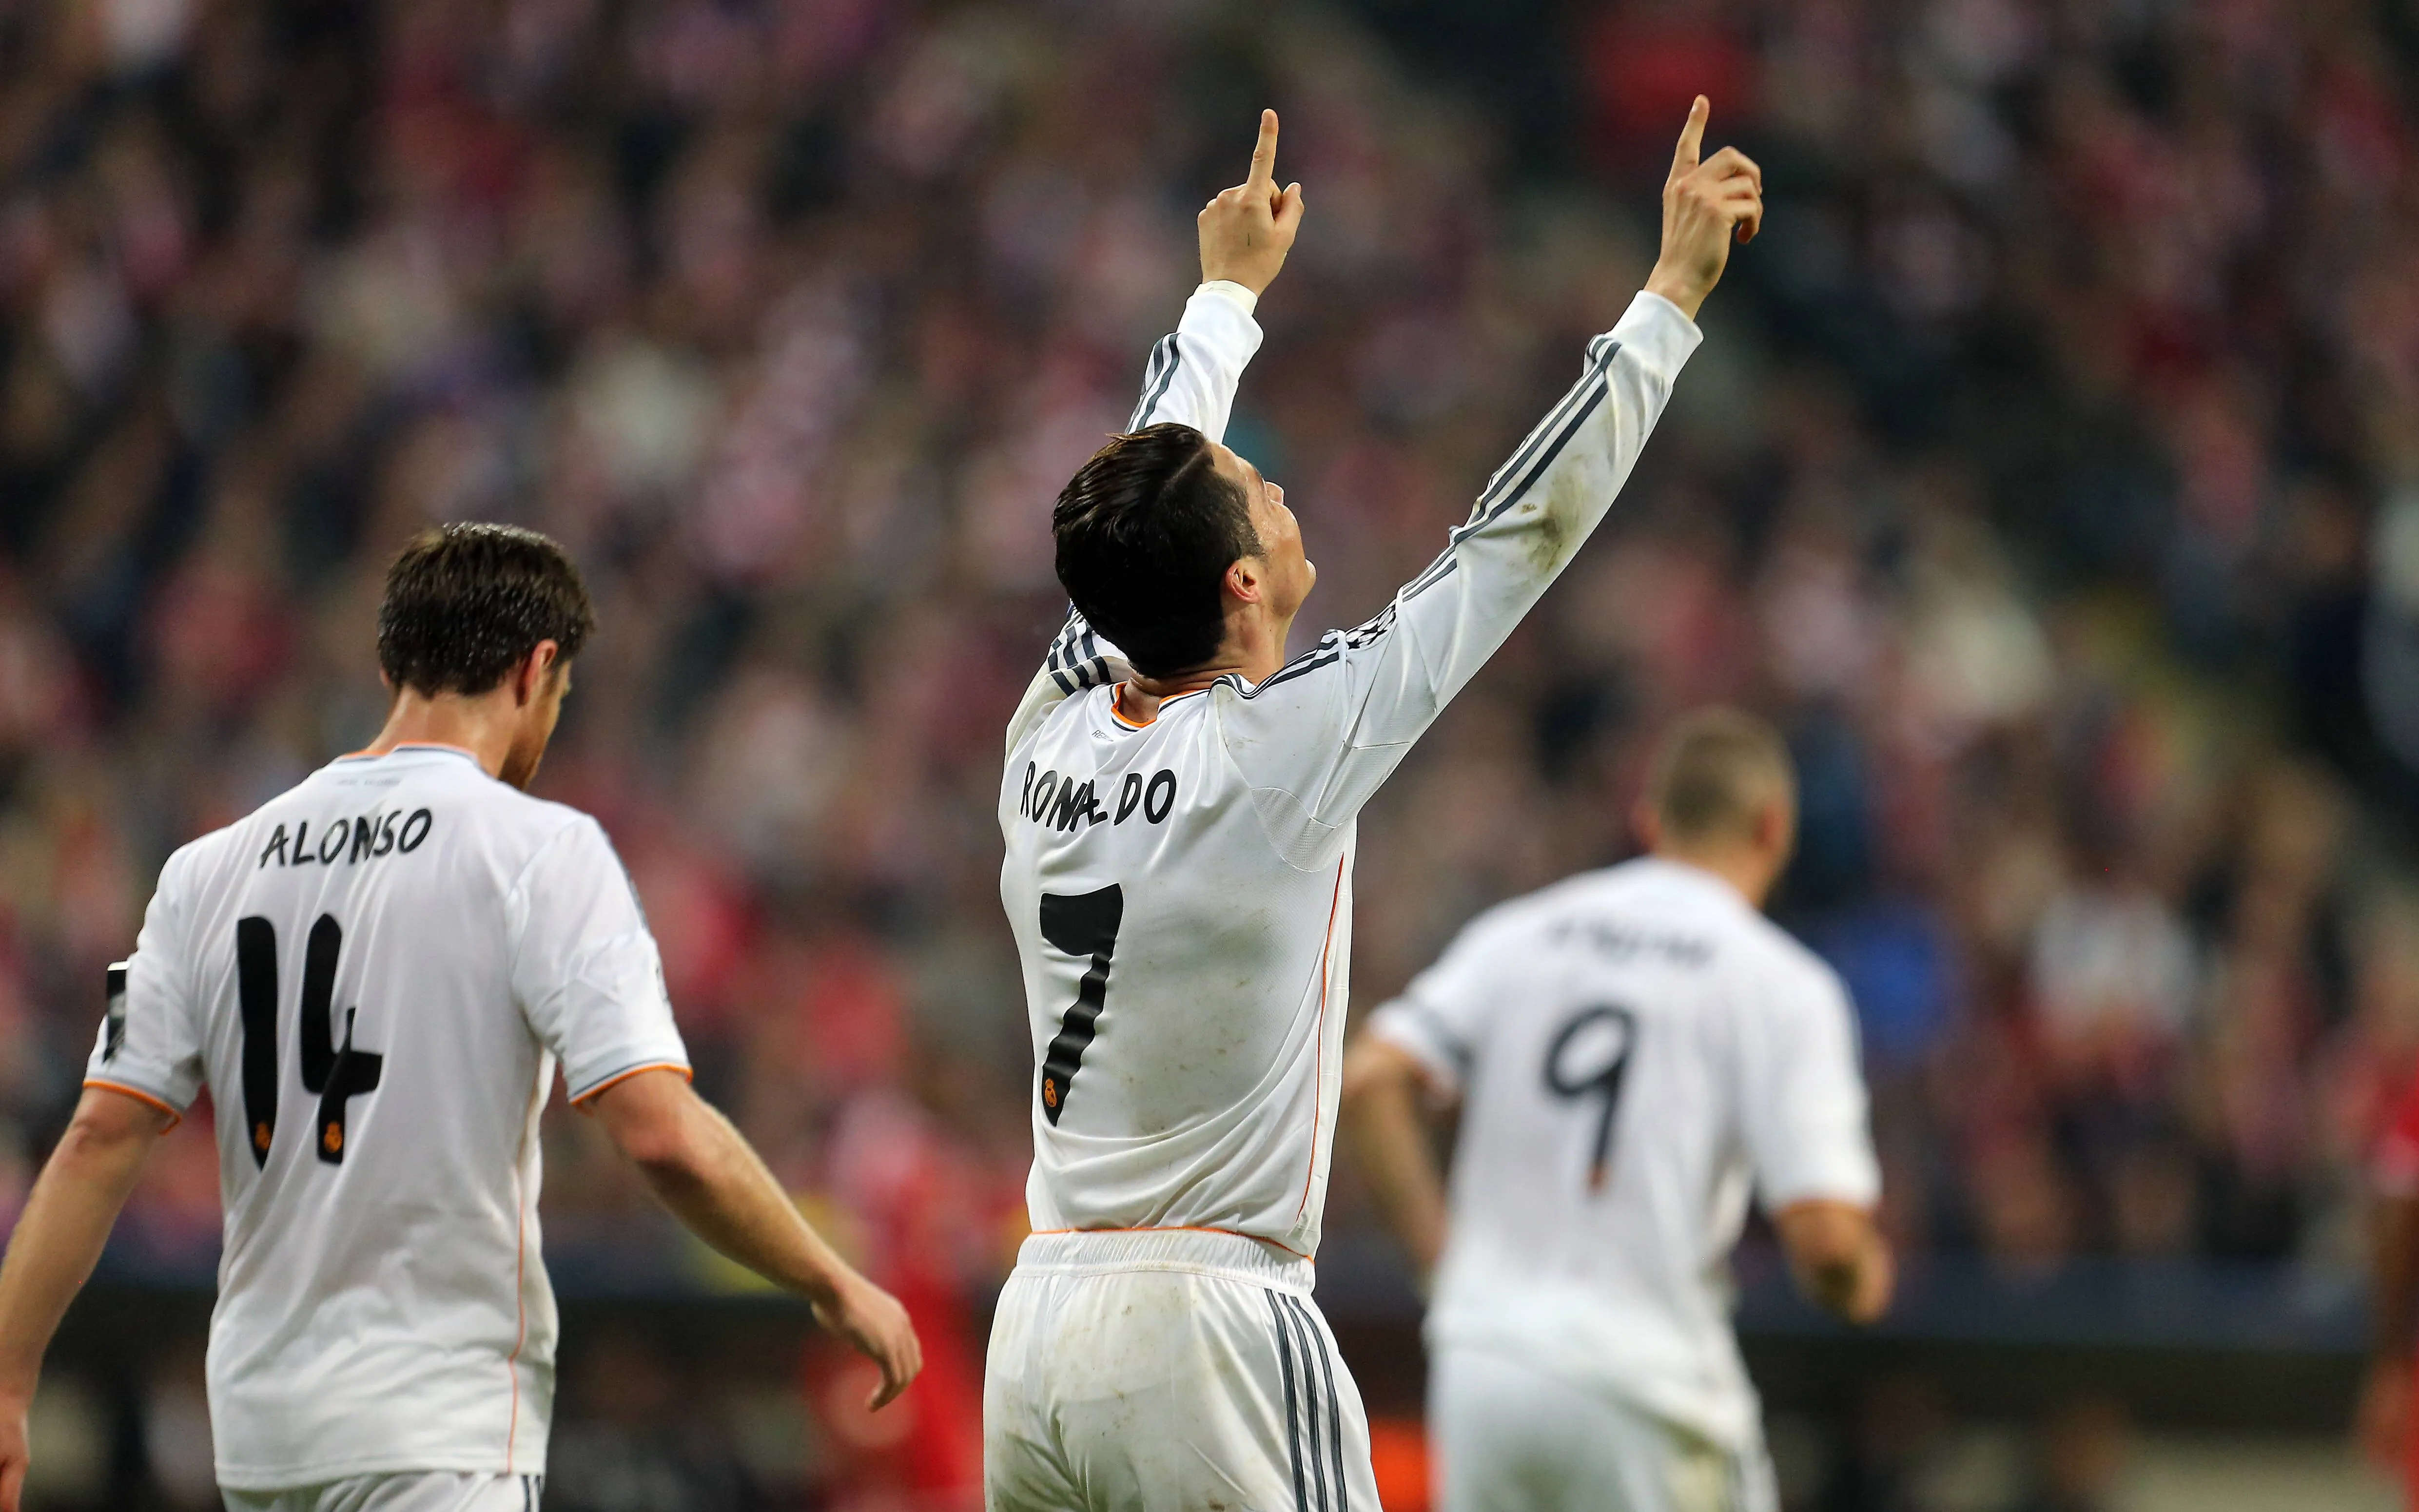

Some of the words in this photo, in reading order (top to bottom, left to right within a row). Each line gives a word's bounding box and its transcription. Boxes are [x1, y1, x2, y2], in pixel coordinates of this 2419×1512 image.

[259, 808, 432, 869] ALONSO
[237, 913, 383, 1172] 14
[1039, 883, 1124, 1127] 7
[1543, 1003, 1639, 1194] 9
